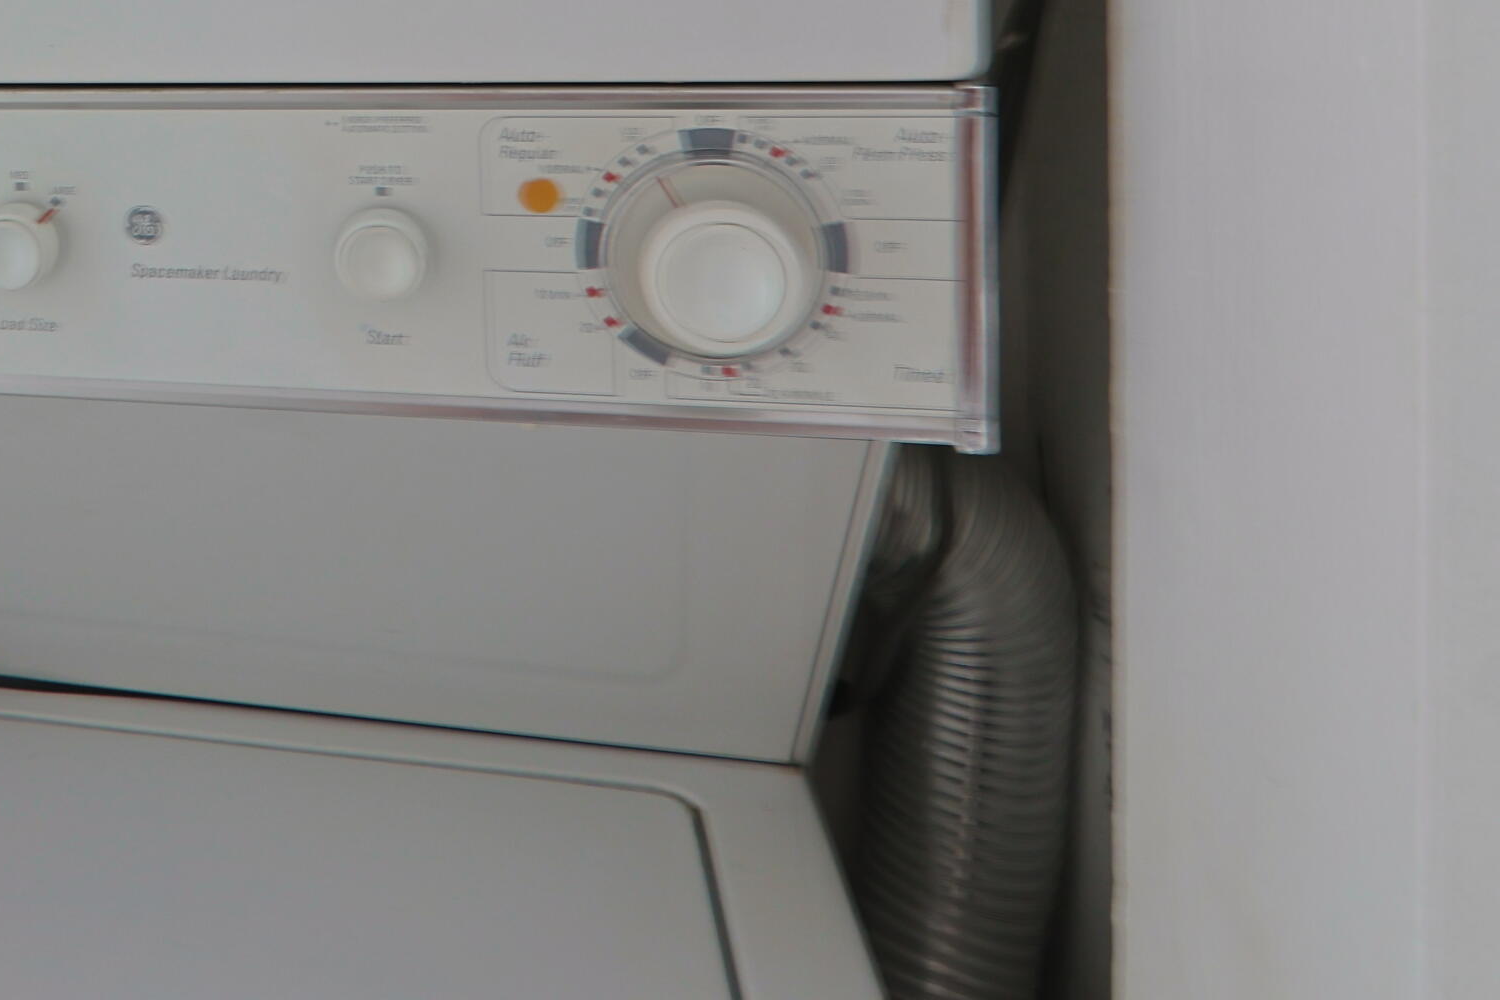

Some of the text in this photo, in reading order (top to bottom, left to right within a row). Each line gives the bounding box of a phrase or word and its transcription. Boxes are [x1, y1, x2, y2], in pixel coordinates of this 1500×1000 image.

[131, 262, 284, 283] Spacemaker Laundry
[27, 317, 58, 332] Size
[365, 329, 404, 345] Start
